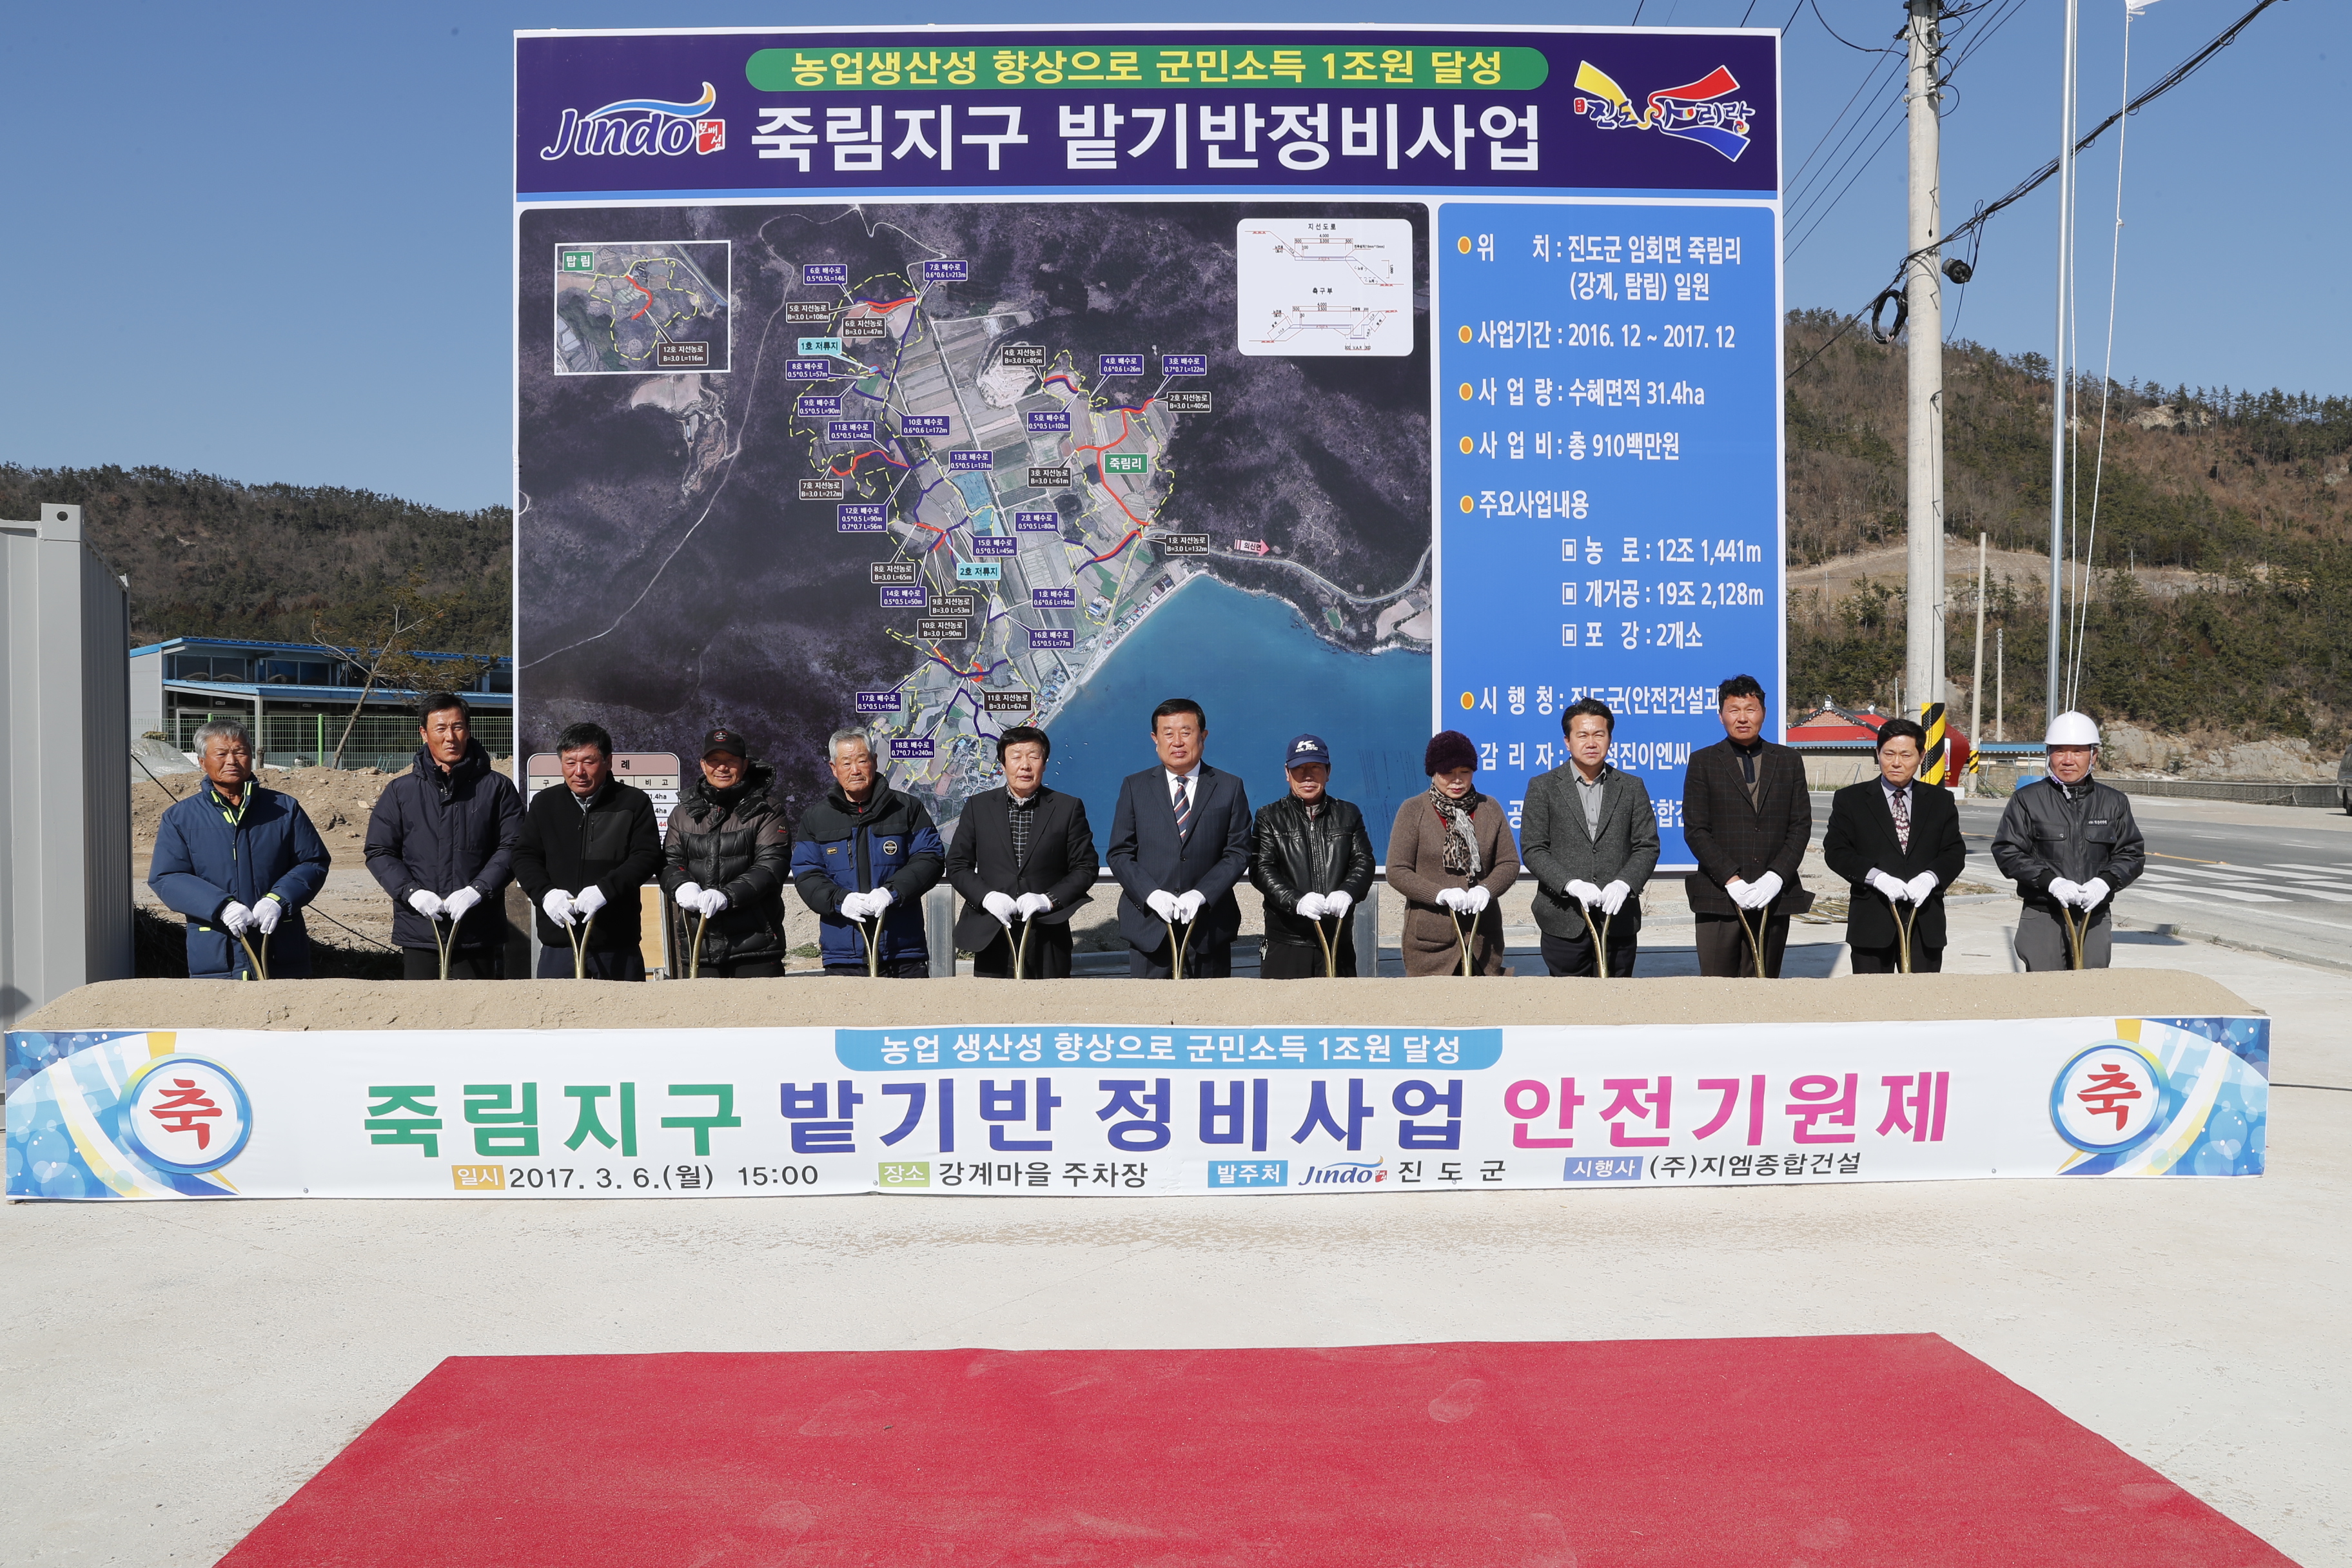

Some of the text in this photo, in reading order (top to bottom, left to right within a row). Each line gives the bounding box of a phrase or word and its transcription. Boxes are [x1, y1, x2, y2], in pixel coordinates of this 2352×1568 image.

[791, 49, 1501, 86] 농업생산성 향상으로 군민소득 1조원 달성
[540, 107, 696, 161] Jindo
[751, 103, 1538, 172] 죽림지구 밭기반정비사업
[1568, 234, 1622, 263] 진도군
[1628, 235, 1681, 264] 임회면
[1687, 236, 1741, 265] 죽림리
[1570, 271, 1618, 301] (강계,
[1674, 272, 1709, 301] 일원
[801, 341, 813, 350] 1호
[1477, 320, 1735, 349] 사업기간 2016. 12 2017. 12
[1568, 378, 1705, 407] 수혜면적 31.4ha
[1568, 431, 1680, 460] 총 910백만원
[1043, 469, 1068, 477] 지선농로
[1109, 457, 1141, 470] 죽림리
[1479, 490, 1589, 520] 주요사업내용
[1657, 538, 1694, 562] 12조
[1701, 539, 1761, 566] 1,441m
[887, 565, 912, 573] 지선농로
[959, 567, 972, 576] 2호
[945, 598, 970, 606] 지선농로
[1585, 579, 1763, 609] 개거공 19조 2,128m
[1656, 621, 1703, 649] 2개소
[1003, 694, 1028, 702] 지선농로
[881, 1032, 1459, 1064] 농업 생산성 향상으로 군민소득 1조원 달성
[2076, 1063, 2142, 1132] 축
[149, 1078, 223, 1150] 축
[364, 1082, 741, 1158] 죽림지구
[1504, 1071, 1950, 1149] 안전기원제
[457, 1168, 498, 1186] 일시
[738, 1165, 818, 1186] 15:00
[883, 1161, 1148, 1188] 장소 강계마을 주차장
[1217, 1164, 1280, 1184] 발주처
[1298, 1165, 1373, 1186] Jindo
[1573, 1159, 1636, 1177] 시행사
